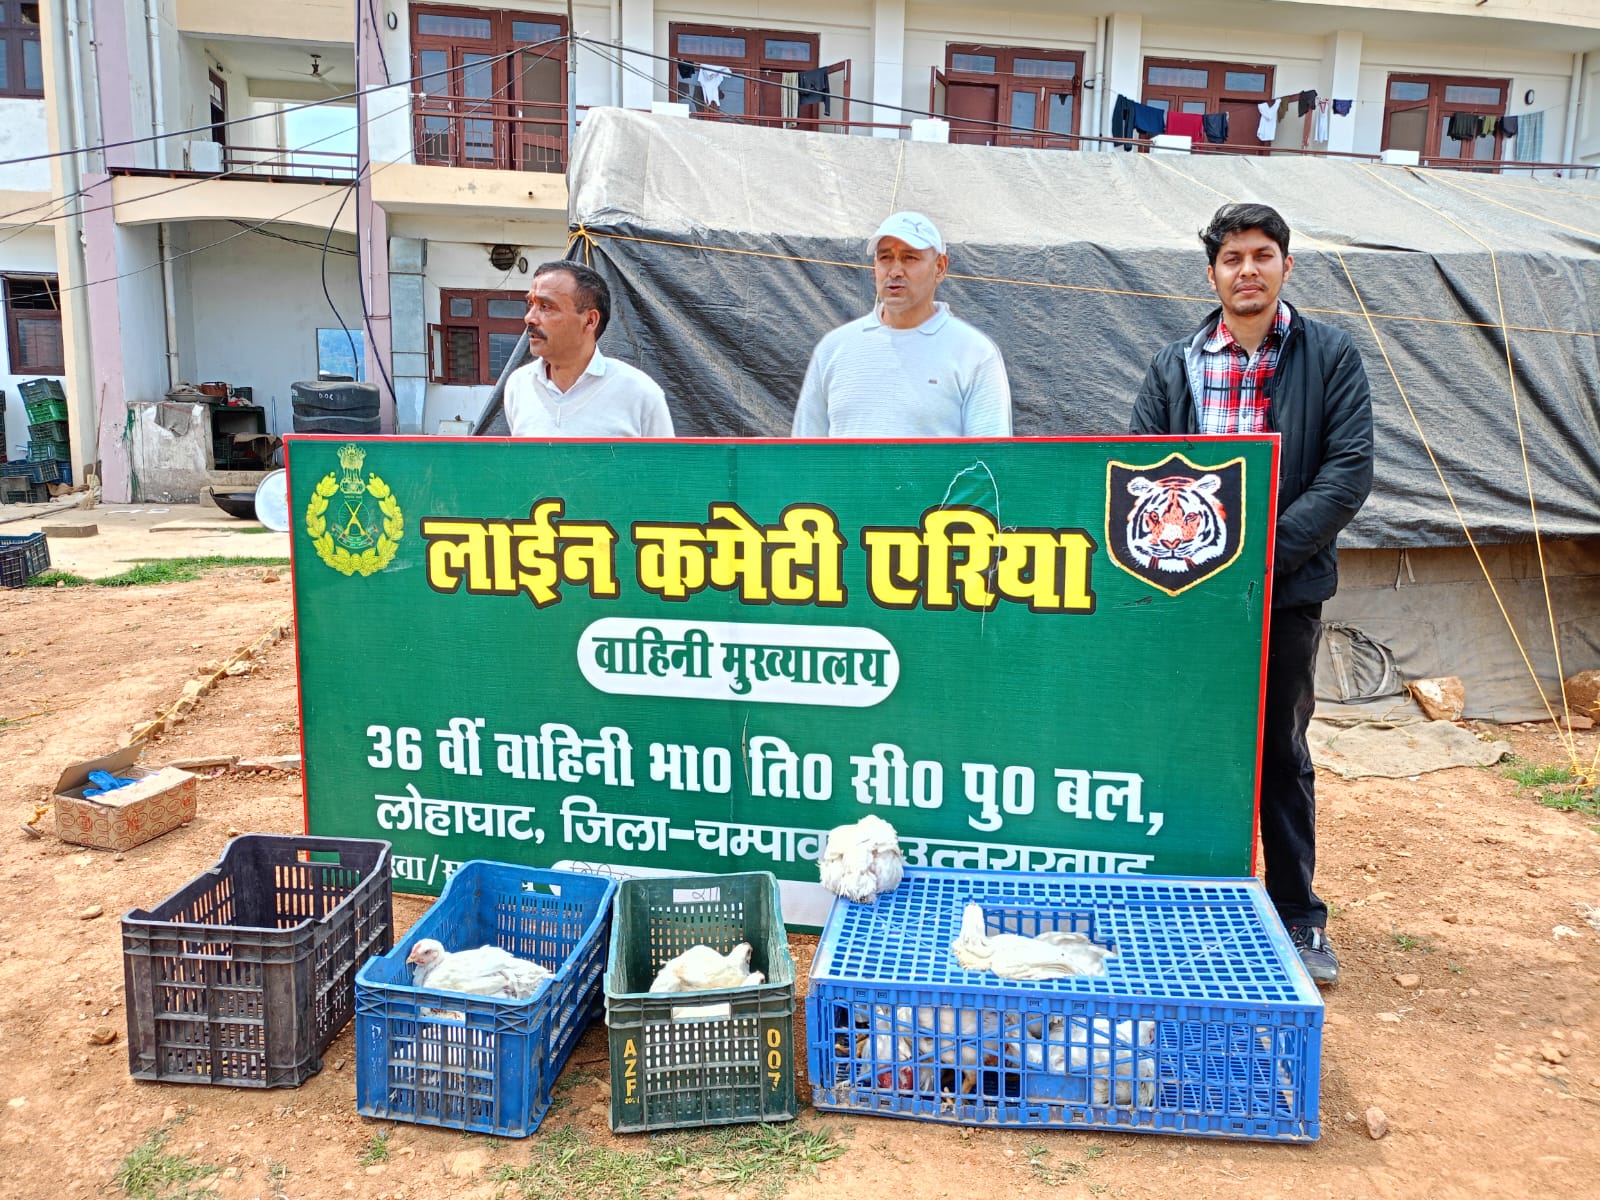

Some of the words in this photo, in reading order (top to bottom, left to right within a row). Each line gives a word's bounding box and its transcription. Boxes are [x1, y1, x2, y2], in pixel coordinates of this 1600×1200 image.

[421, 499, 618, 607] लाईन
[633, 503, 846, 605] कमेटी
[863, 506, 1095, 612] एरिया
[591, 626, 714, 678] वाहिनी
[720, 643, 890, 695] मुख्यालय
[367, 725, 422, 771] 36
[436, 718, 486, 776] वीं
[494, 723, 635, 788] वाहिनी
[1054, 768, 1164, 836] बल,
[374, 784, 545, 845] लोहाघाट,
[623, 1038, 638, 1097] AZF
[766, 1028, 782, 1092] 007
